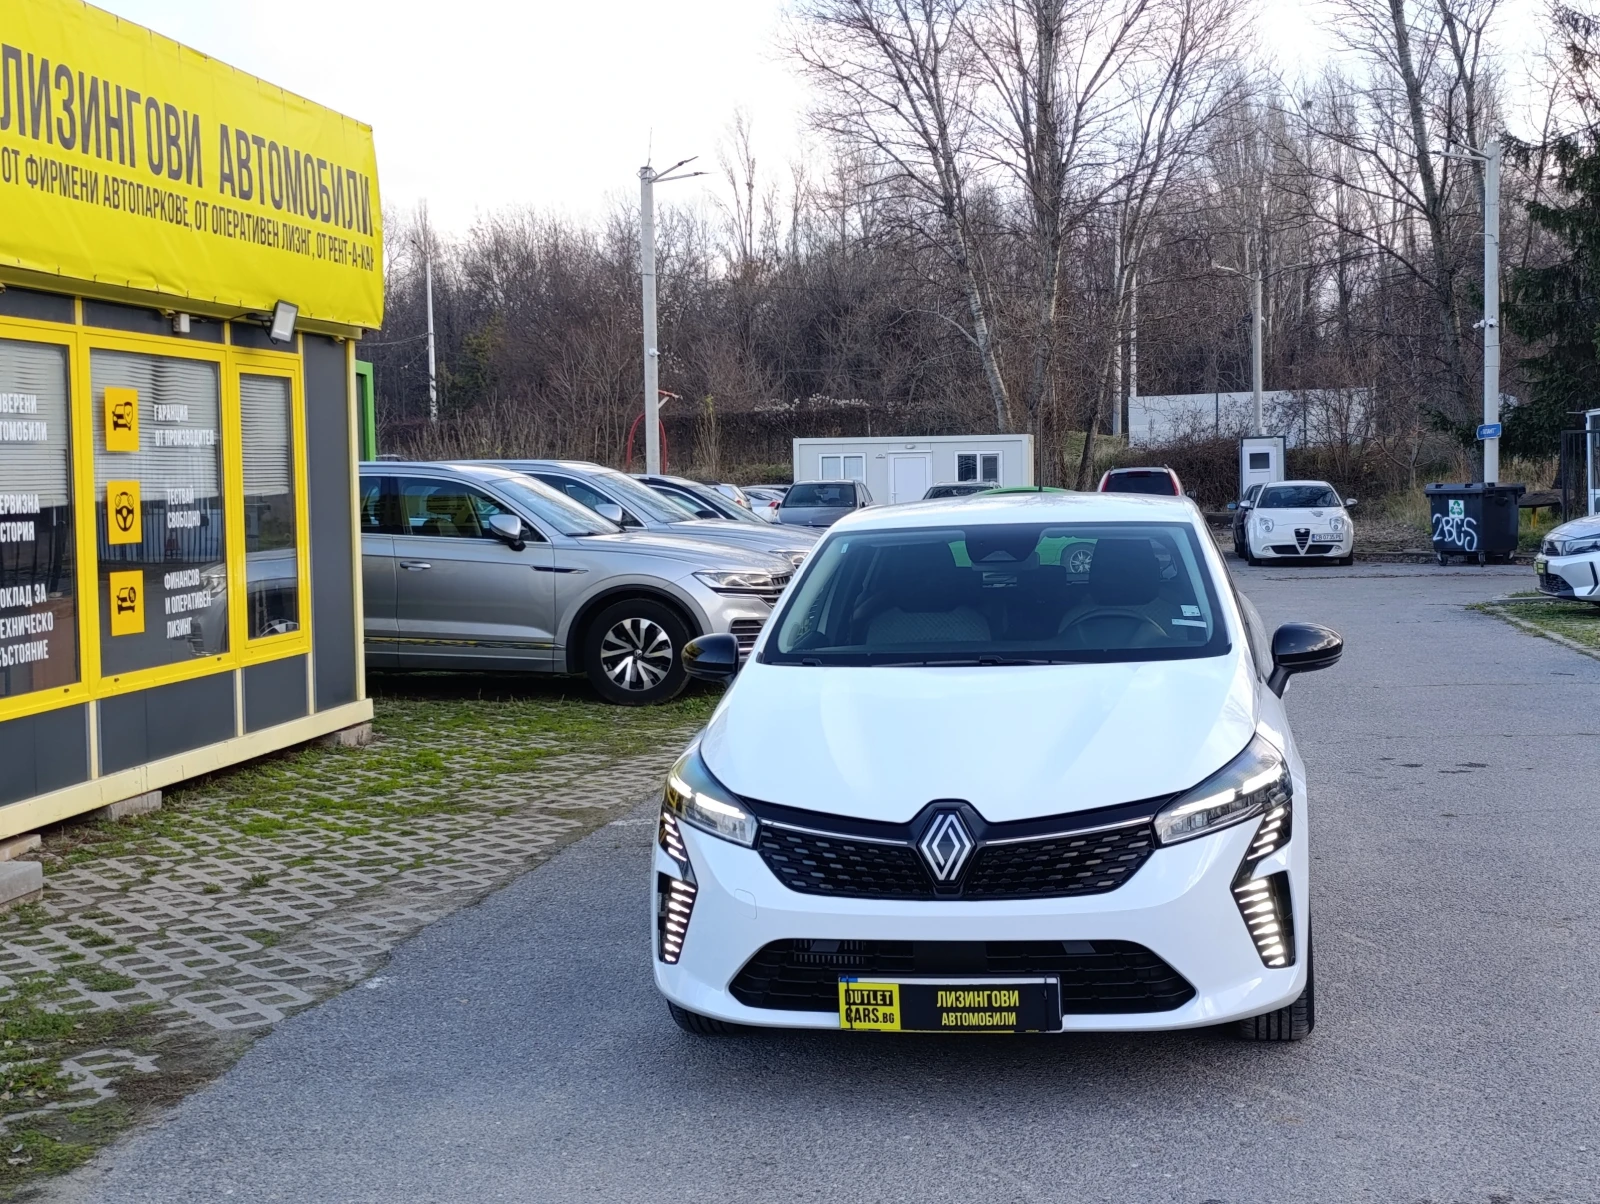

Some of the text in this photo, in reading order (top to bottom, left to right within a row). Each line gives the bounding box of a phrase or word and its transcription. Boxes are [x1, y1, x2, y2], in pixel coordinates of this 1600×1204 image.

[1, 43, 373, 237] ЛИЗИНГОВИ АВТОМОБИЛИ
[2, 146, 20, 185] ОТ
[25, 154, 99, 205] ФИРМЕНИ
[103, 174, 192, 232] АВТОПАРКОВЕ,
[195, 200, 209, 232] ОТ
[211, 204, 279, 249] ОПЕРАТИВЕН
[317, 232, 326, 260] ОТ
[154, 404, 189, 423] ГАРАНЦИЯ
[155, 430, 164, 446] ОТ
[167, 485, 194, 505] ТЕСТВАЙ
[167, 510, 201, 529] СВОБОДНО
[0, 521, 35, 543] СТОРИЯ
[164, 568, 200, 590] ФИНАНСОВ
[0, 583, 47, 609] ОКЛАД ЗА
[171, 590, 211, 613] ОПЕРАТИВЕН
[167, 617, 192, 639] ЛИЗИНГ
[0, 639, 49, 667] ЪСТОЯНИЕ
[846, 990, 892, 1005] OUTLET
[936, 990, 1019, 1008] ЛИЗИНГОВИ
[845, 1007, 895, 1024] CARS.BG
[941, 1011, 1017, 1026] АВТОМОБИЛИ
